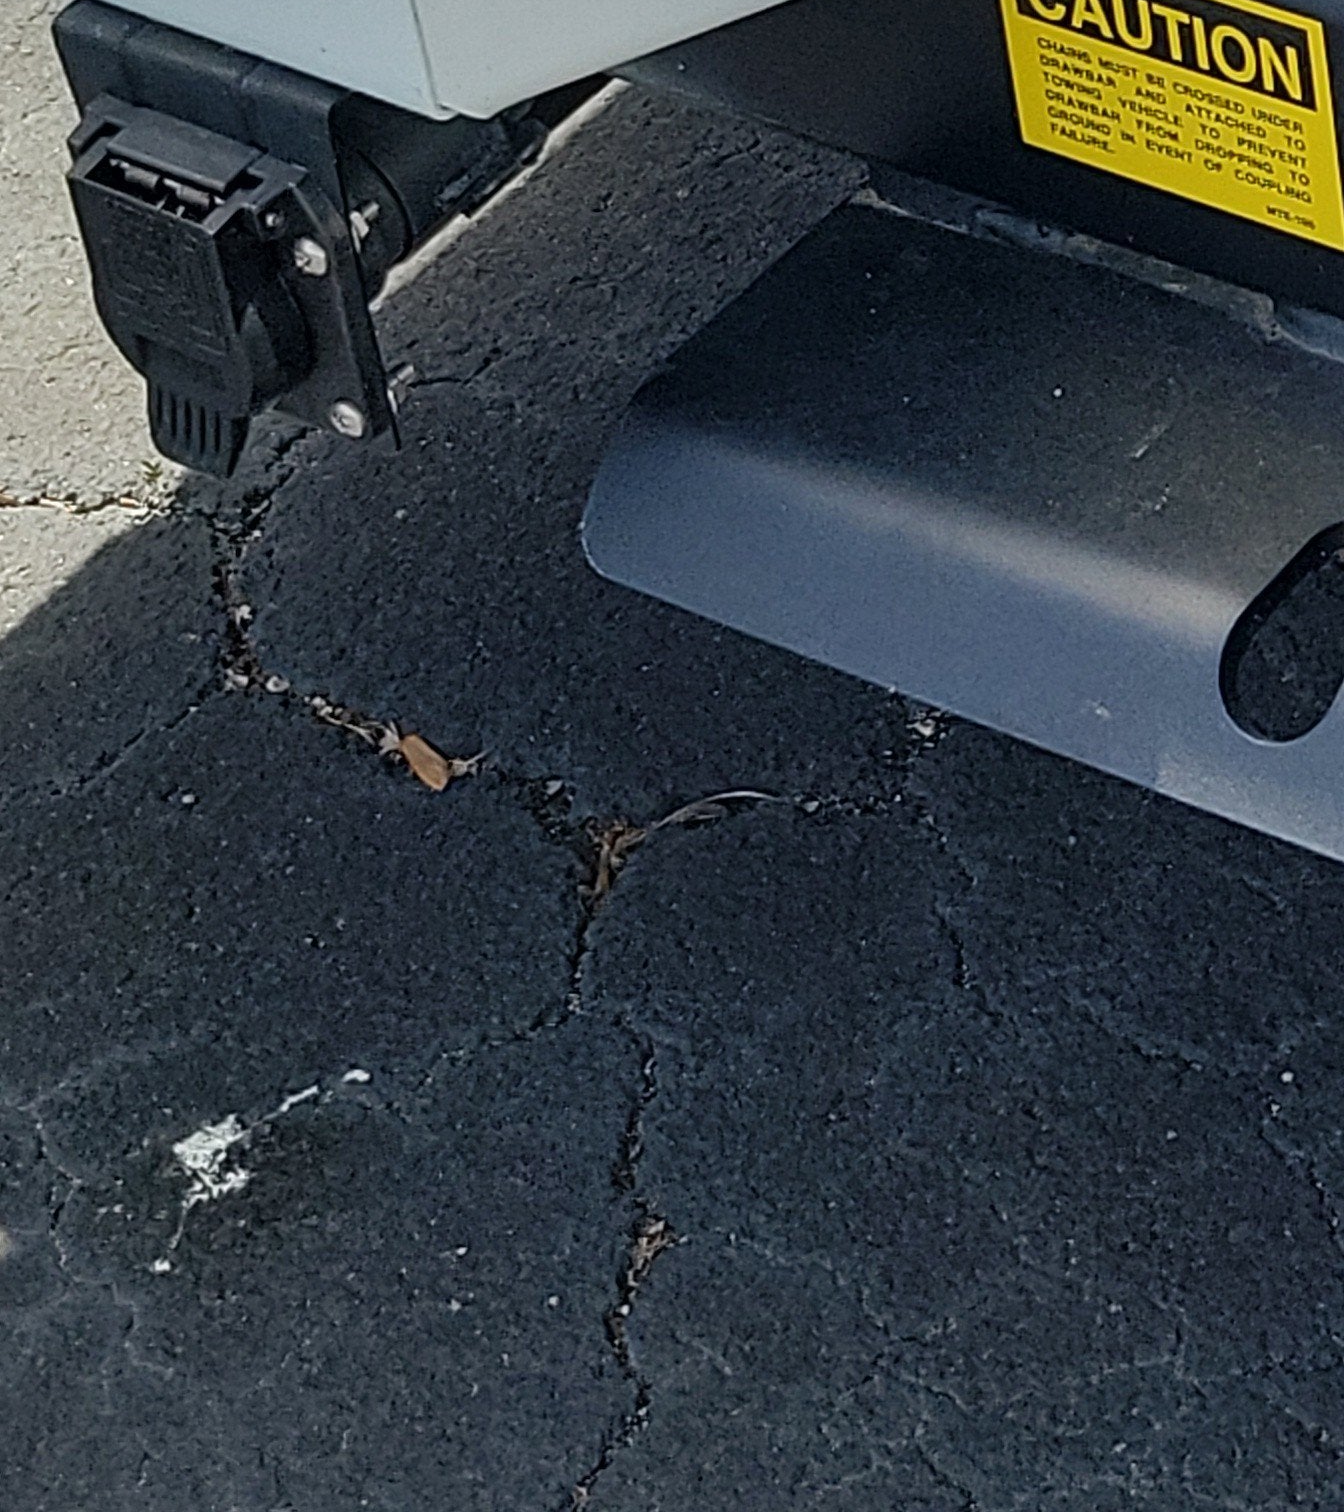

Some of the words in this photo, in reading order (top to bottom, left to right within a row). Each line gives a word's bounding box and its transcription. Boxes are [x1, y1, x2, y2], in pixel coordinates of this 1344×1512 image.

[1037, 38, 1091, 64] CHAINS
[1098, 57, 1137, 79] MUST
[1145, 73, 1164, 88] BE
[1173, 81, 1244, 113] CROSSED
[1252, 107, 1302, 132] UNDER
[1039, 55, 1116, 88] DRAWBAR
[1135, 87, 1165, 104] AND
[1184, 103, 1265, 137] ATTACHED
[1286, 136, 1305, 150] TO
[1044, 73, 1100, 99] TOWING
[1118, 98, 1182, 126] VEHICLE
[1200, 125, 1220, 138] TO
[1237, 137, 1306, 167] PREVENT
[1044, 90, 1120, 122] DRAWBAR
[1136, 120, 1178, 141] FROM
[1195, 140, 1273, 173] DROPPING
[1290, 171, 1309, 185] TO
[1047, 106, 1110, 135] GROUND
[1121, 131, 1134, 143] IN
[1146, 139, 1193, 163] EVENT
[1204, 158, 1222, 173] OF
[1235, 169, 1310, 202] COUPLING
